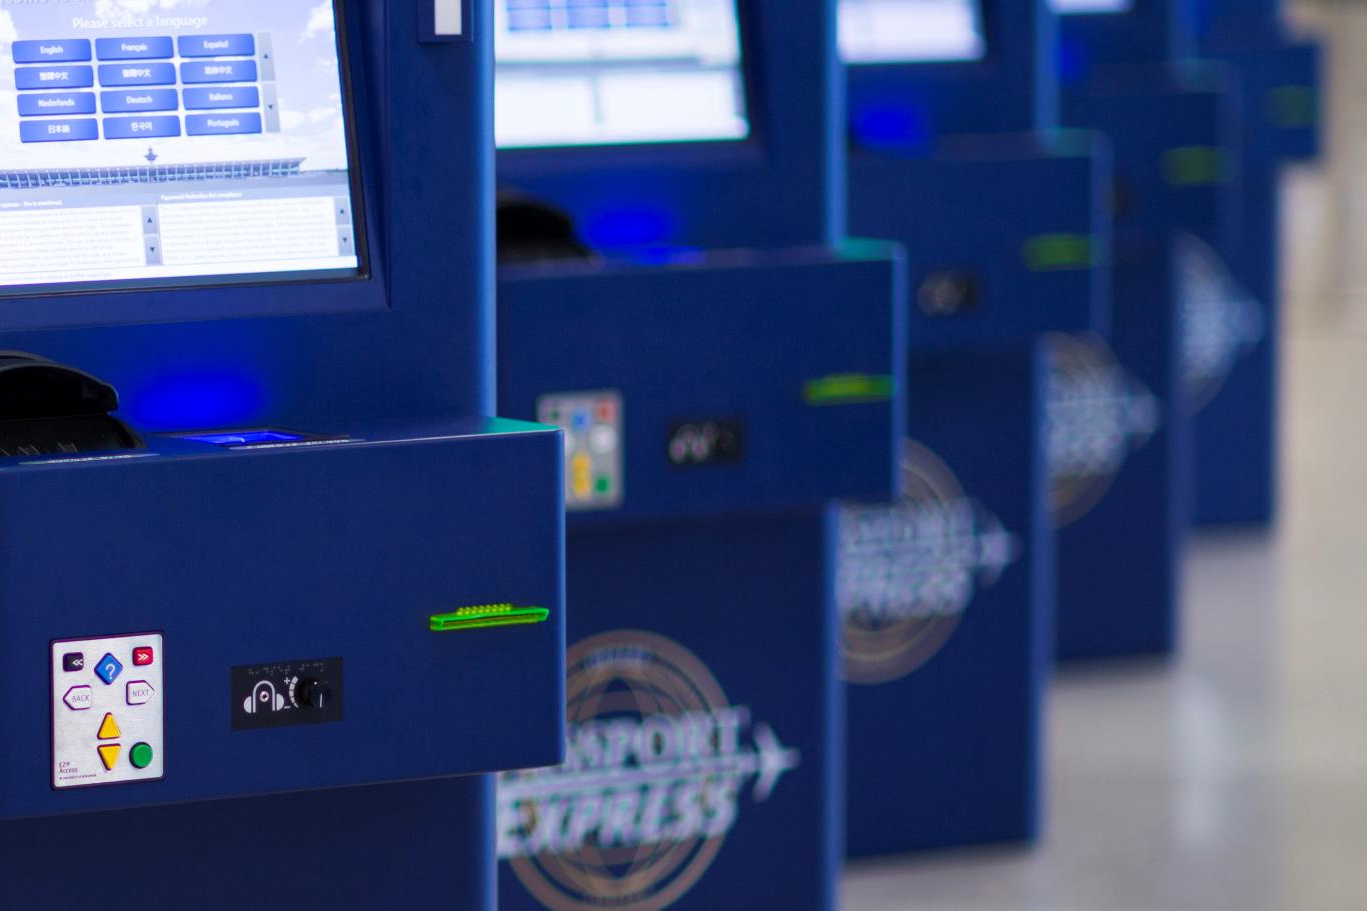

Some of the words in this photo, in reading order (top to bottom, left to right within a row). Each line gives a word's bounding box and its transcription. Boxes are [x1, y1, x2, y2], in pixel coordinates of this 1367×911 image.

[72, 17, 108, 29] Please
[110, 16, 143, 28] select
[155, 15, 208, 30] language
[40, 45, 64, 56] English
[126, 95, 153, 105] Deutsch
[208, 93, 233, 101] Italiano
[37, 98, 75, 108] Nederlands
[132, 689, 150, 697] NEXT
[71, 694, 90, 703] BACK
[495, 779, 739, 858] EXPRESS
